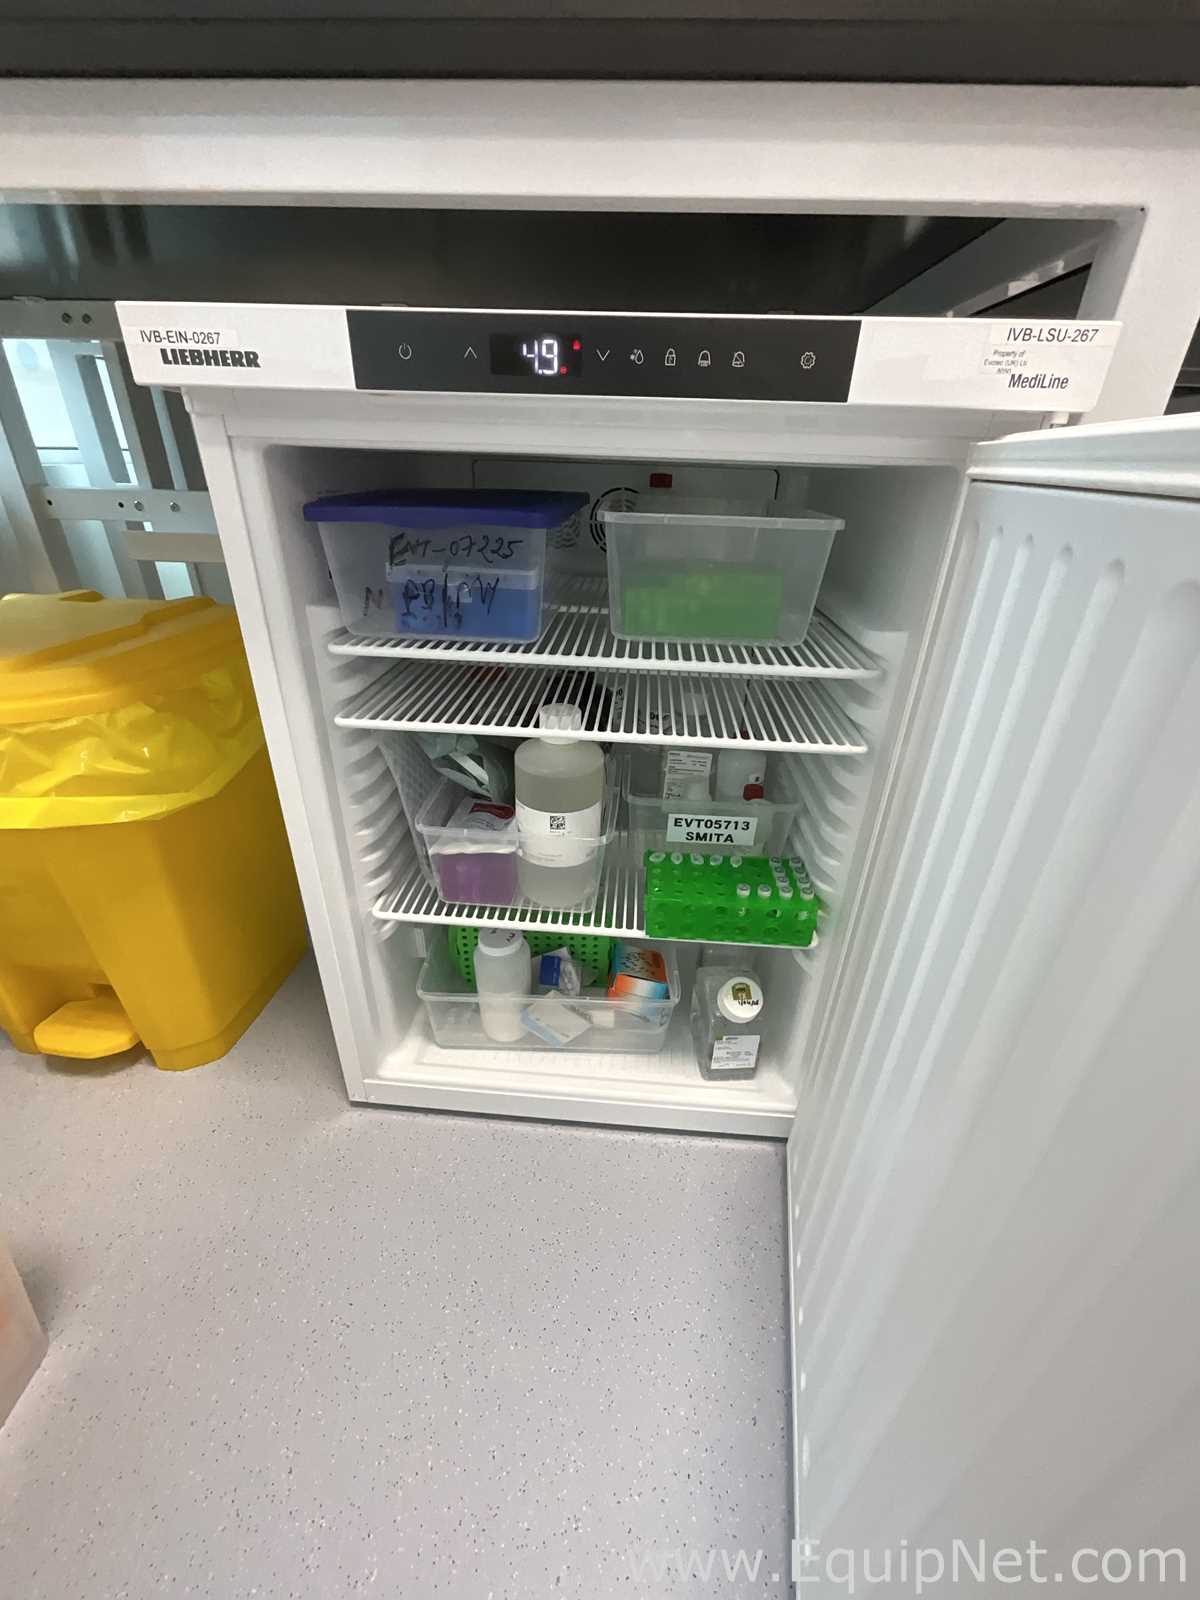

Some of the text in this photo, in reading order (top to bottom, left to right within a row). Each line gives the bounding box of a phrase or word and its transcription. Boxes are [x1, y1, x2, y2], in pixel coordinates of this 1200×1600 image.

[139, 329, 221, 345] IVB-EIN-0267
[1007, 327, 1099, 343] IVB-LSU-267
[160, 348, 261, 368] LIEBHERR
[1008, 373, 1069, 390] MediLine
[673, 817, 750, 831] EVT05713
[685, 831, 734, 843] SMITA
